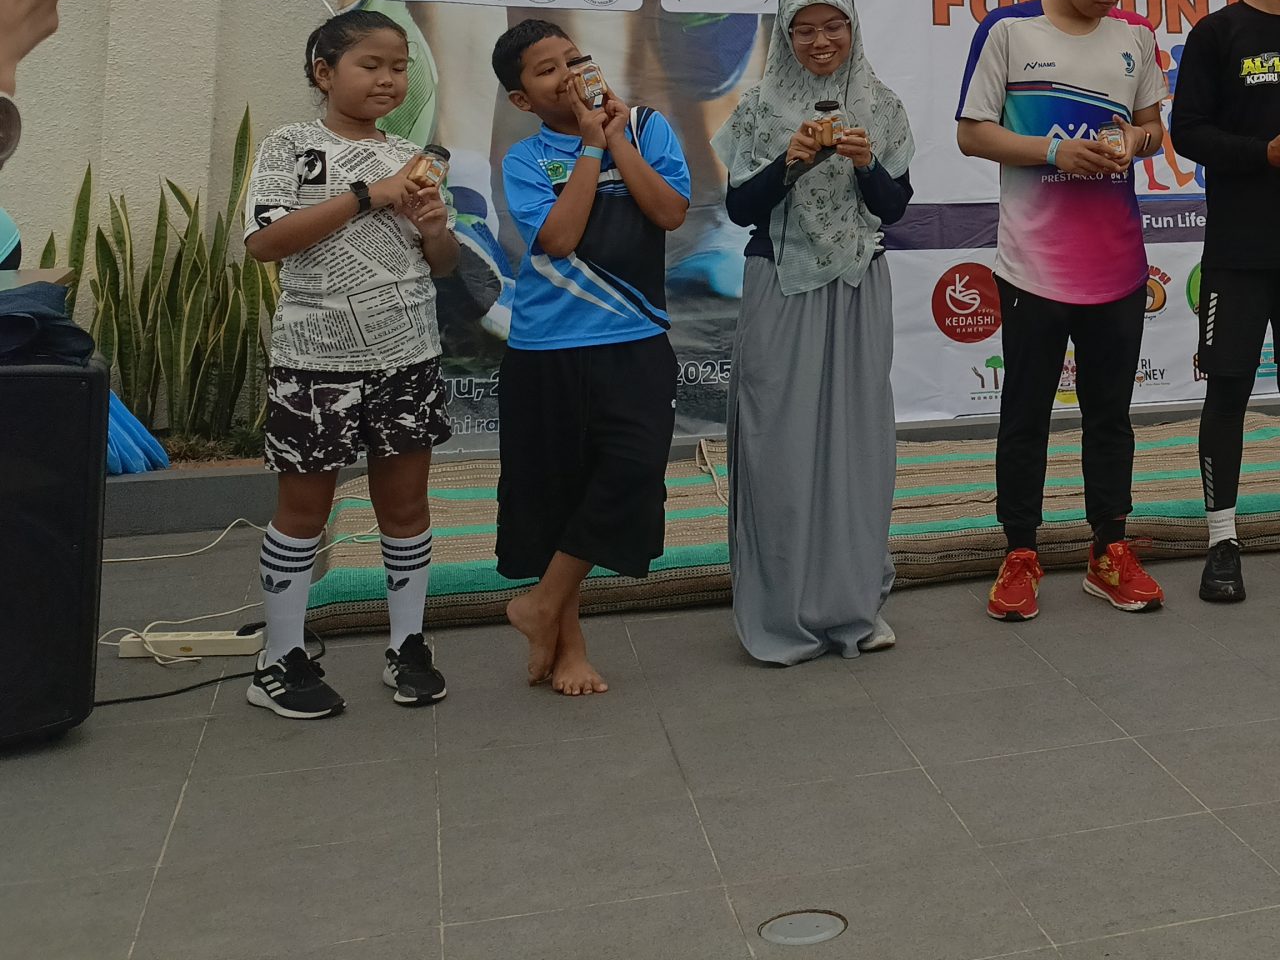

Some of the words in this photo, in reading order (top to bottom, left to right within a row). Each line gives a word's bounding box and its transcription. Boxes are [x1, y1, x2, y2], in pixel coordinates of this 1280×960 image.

[1246, 72, 1278, 84] KEDIRI
[1142, 214, 1174, 229] Fun
[1177, 211, 1208, 227] Life
[945, 315, 995, 327] KEDAISHI
[1141, 358, 1152, 370] RI
[1145, 368, 1166, 381] NEY
